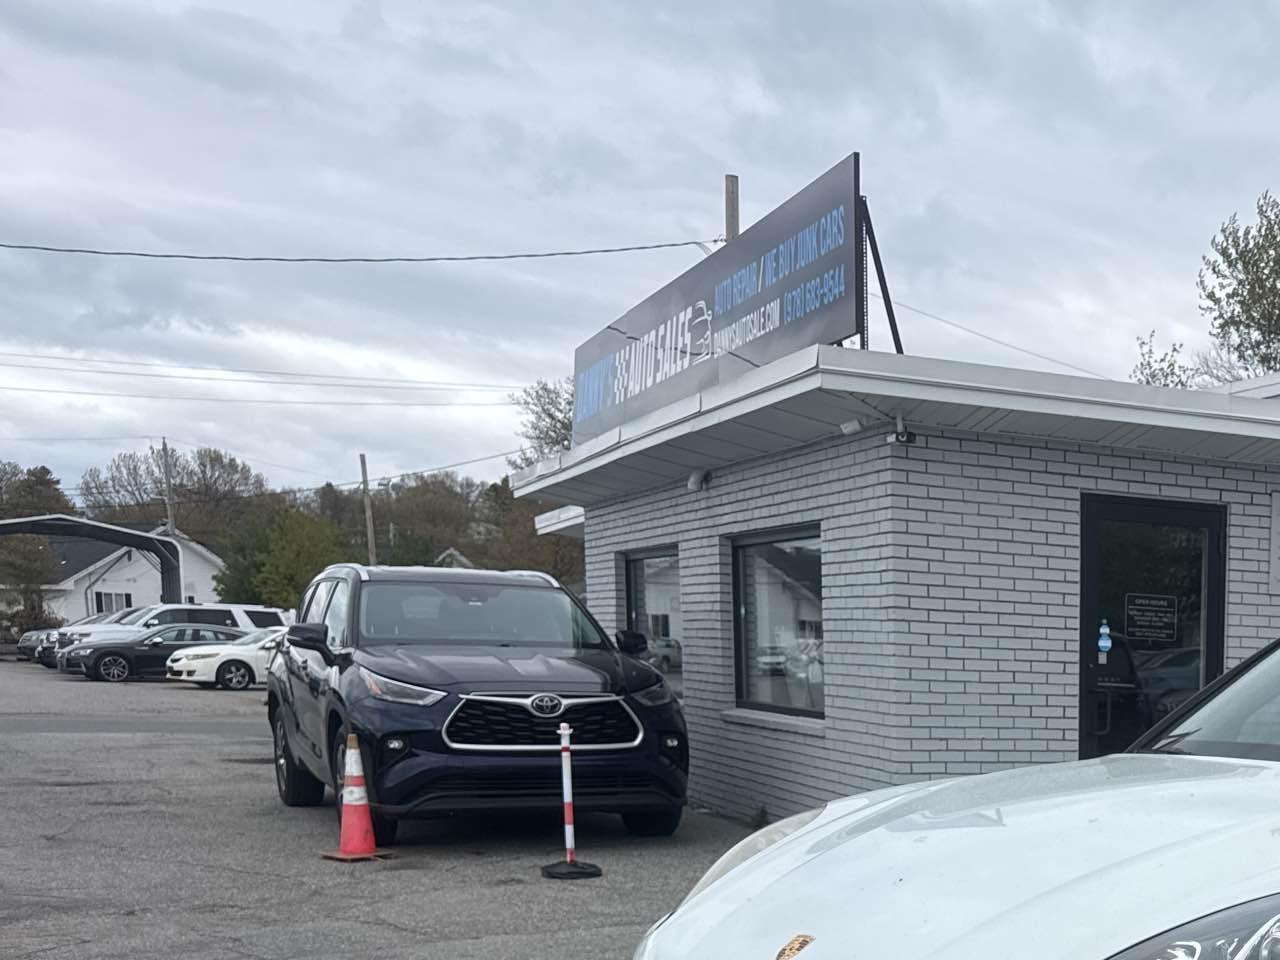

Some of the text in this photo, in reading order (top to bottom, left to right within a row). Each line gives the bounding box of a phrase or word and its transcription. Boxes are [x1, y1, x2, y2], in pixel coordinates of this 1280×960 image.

[764, 248, 778, 288] WE
[779, 233, 796, 280] BUY
[796, 221, 818, 271] JUNK
[820, 204, 845, 256] CARS
[626, 329, 657, 399] AUTO
[656, 305, 693, 384] SALES
